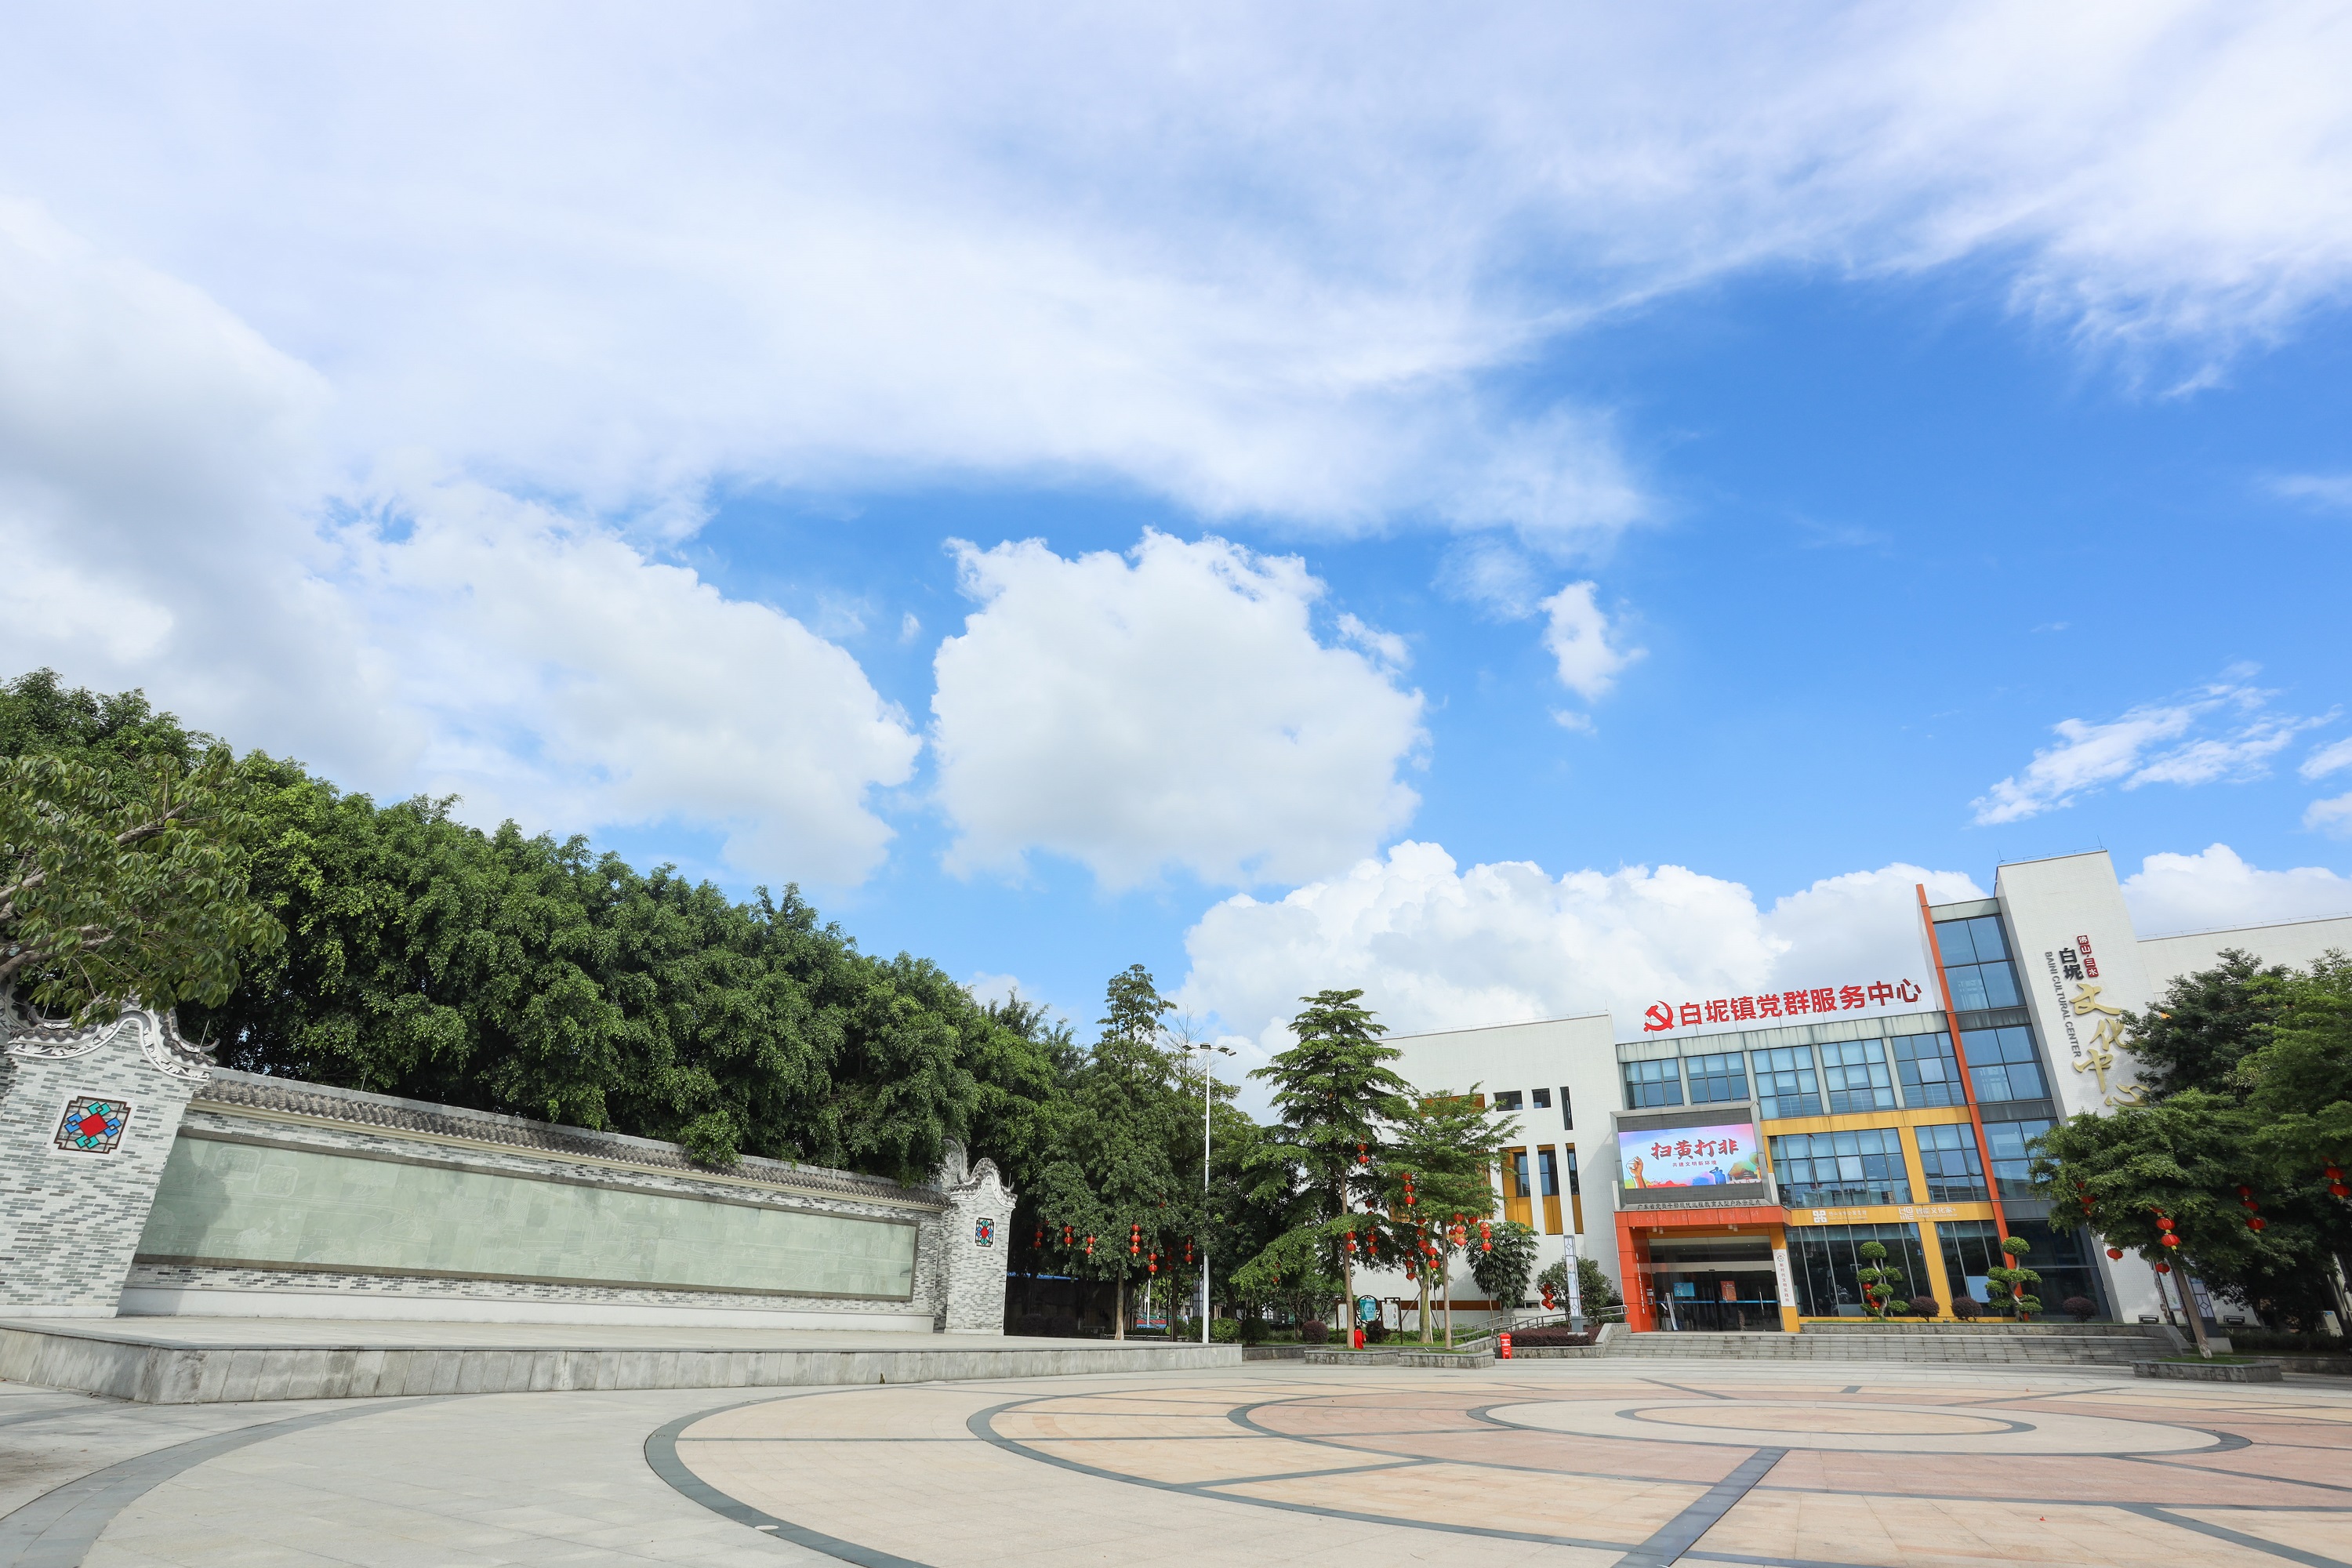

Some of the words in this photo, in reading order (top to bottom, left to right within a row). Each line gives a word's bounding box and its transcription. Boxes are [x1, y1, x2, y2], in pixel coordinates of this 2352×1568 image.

[2059, 947, 2084, 981] 白坭
[1679, 978, 1922, 1026] 白坭镇党群服务中心
[2045, 951, 2059, 975] BAINI
[2052, 975, 2071, 1020] CULTURAL
[2064, 1021, 2082, 1058] CENTER
[1650, 1138, 1740, 1160] 扫黄打非
